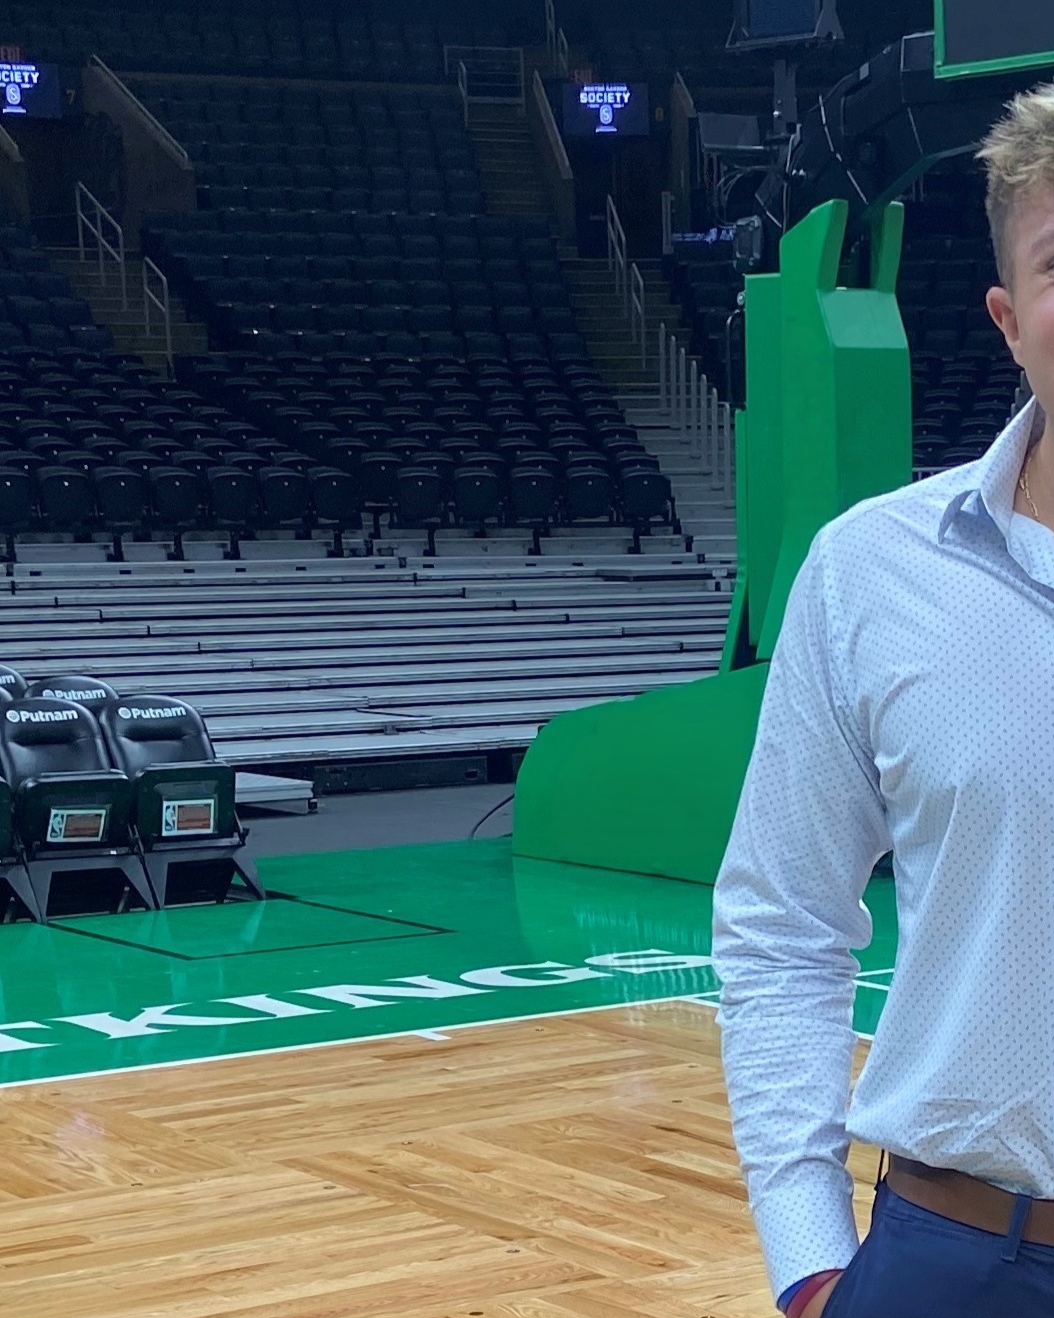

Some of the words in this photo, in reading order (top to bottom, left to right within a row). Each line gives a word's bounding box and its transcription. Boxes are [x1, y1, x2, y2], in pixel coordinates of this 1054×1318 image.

[0, 70, 40, 84] CIETY
[579, 91, 631, 103] SOCIETY
[54, 688, 106, 700] Putnam
[20, 709, 79, 722] Putnam
[132, 706, 187, 719] Putnam
